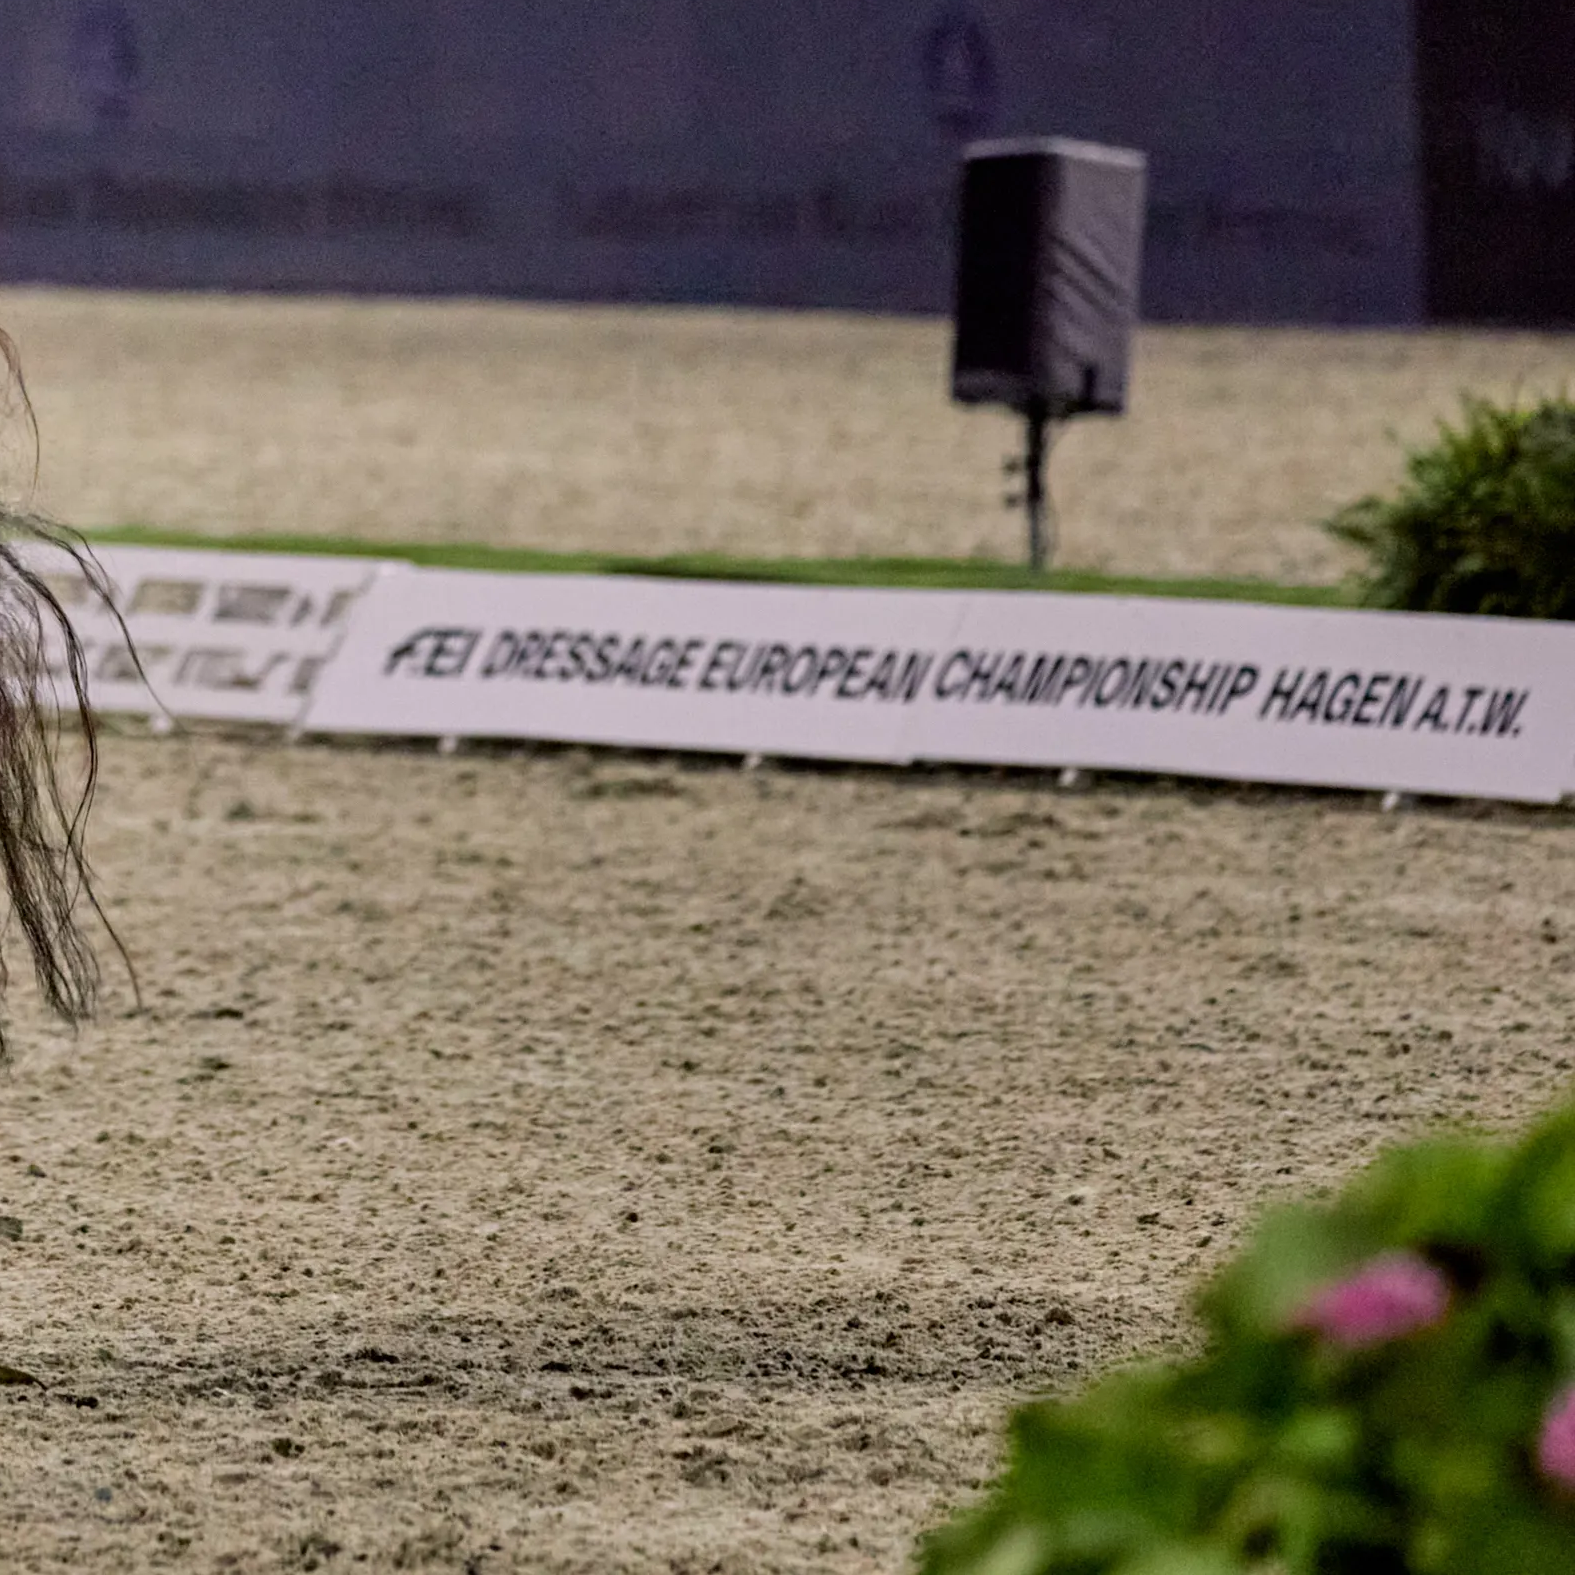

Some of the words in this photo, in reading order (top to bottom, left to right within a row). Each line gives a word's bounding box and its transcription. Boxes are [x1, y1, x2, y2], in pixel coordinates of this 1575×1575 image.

[481, 629, 706, 691] DRESSAGE
[698, 639, 932, 704] EUROPEAN
[933, 647, 1259, 719] CHAMPIONSHIP
[1259, 665, 1424, 730] HAGEN
[1415, 682, 1531, 740] A.T.W.
